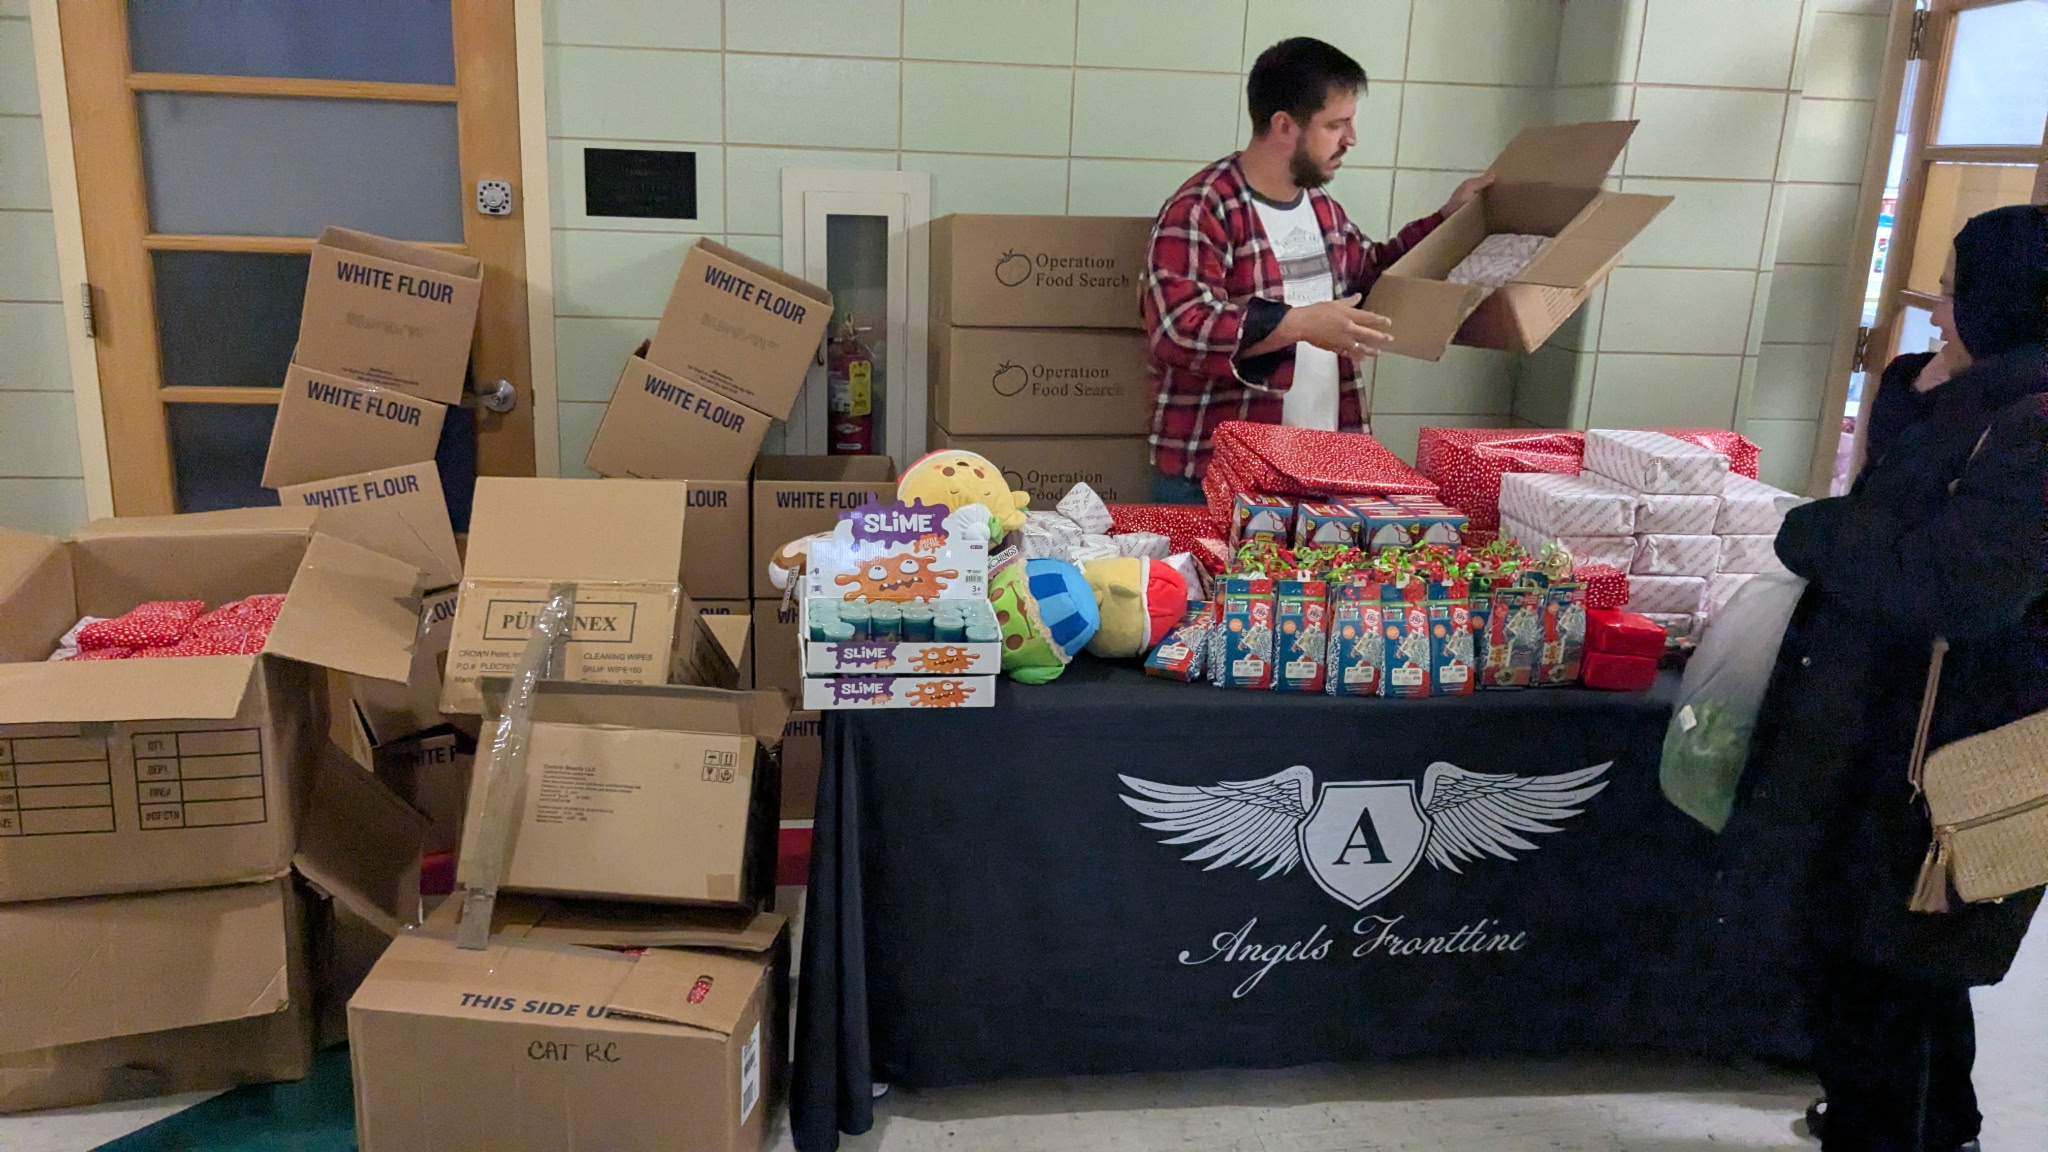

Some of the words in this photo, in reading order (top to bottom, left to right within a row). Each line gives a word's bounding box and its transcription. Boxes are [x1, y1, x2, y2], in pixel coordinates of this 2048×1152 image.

[1035, 253, 1115, 271] Operation
[337, 261, 394, 290] WHITE
[397, 275, 454, 304] FLOUR
[1035, 273, 1074, 287] Food
[1079, 273, 1130, 288] Search
[704, 265, 755, 302] WHITE
[755, 289, 807, 325] FLOUR
[1031, 364, 1109, 379] Operation
[1031, 383, 1069, 397] Food
[306, 380, 363, 412] WHITE
[365, 396, 422, 427] FLOUR
[643, 374, 695, 411] WHITE
[694, 398, 746, 433] FLOUR
[1026, 470, 1103, 485] Operation
[303, 484, 361, 509] WHITE
[363, 475, 420, 500] FLOUR
[686, 490, 728, 509] LOUR
[776, 491, 825, 509] WHITE
[830, 491, 878, 510] FLOU
[1028, 488, 1063, 502] Food
[583, 652, 626, 661] CLEANING
[627, 653, 654, 661] WIPES
[1331, 806, 1393, 865] A
[1178, 916, 1334, 999] Angels
[460, 992, 517, 1011] THIS
[521, 999, 581, 1018] SIDE
[527, 1041, 578, 1061] CAT
